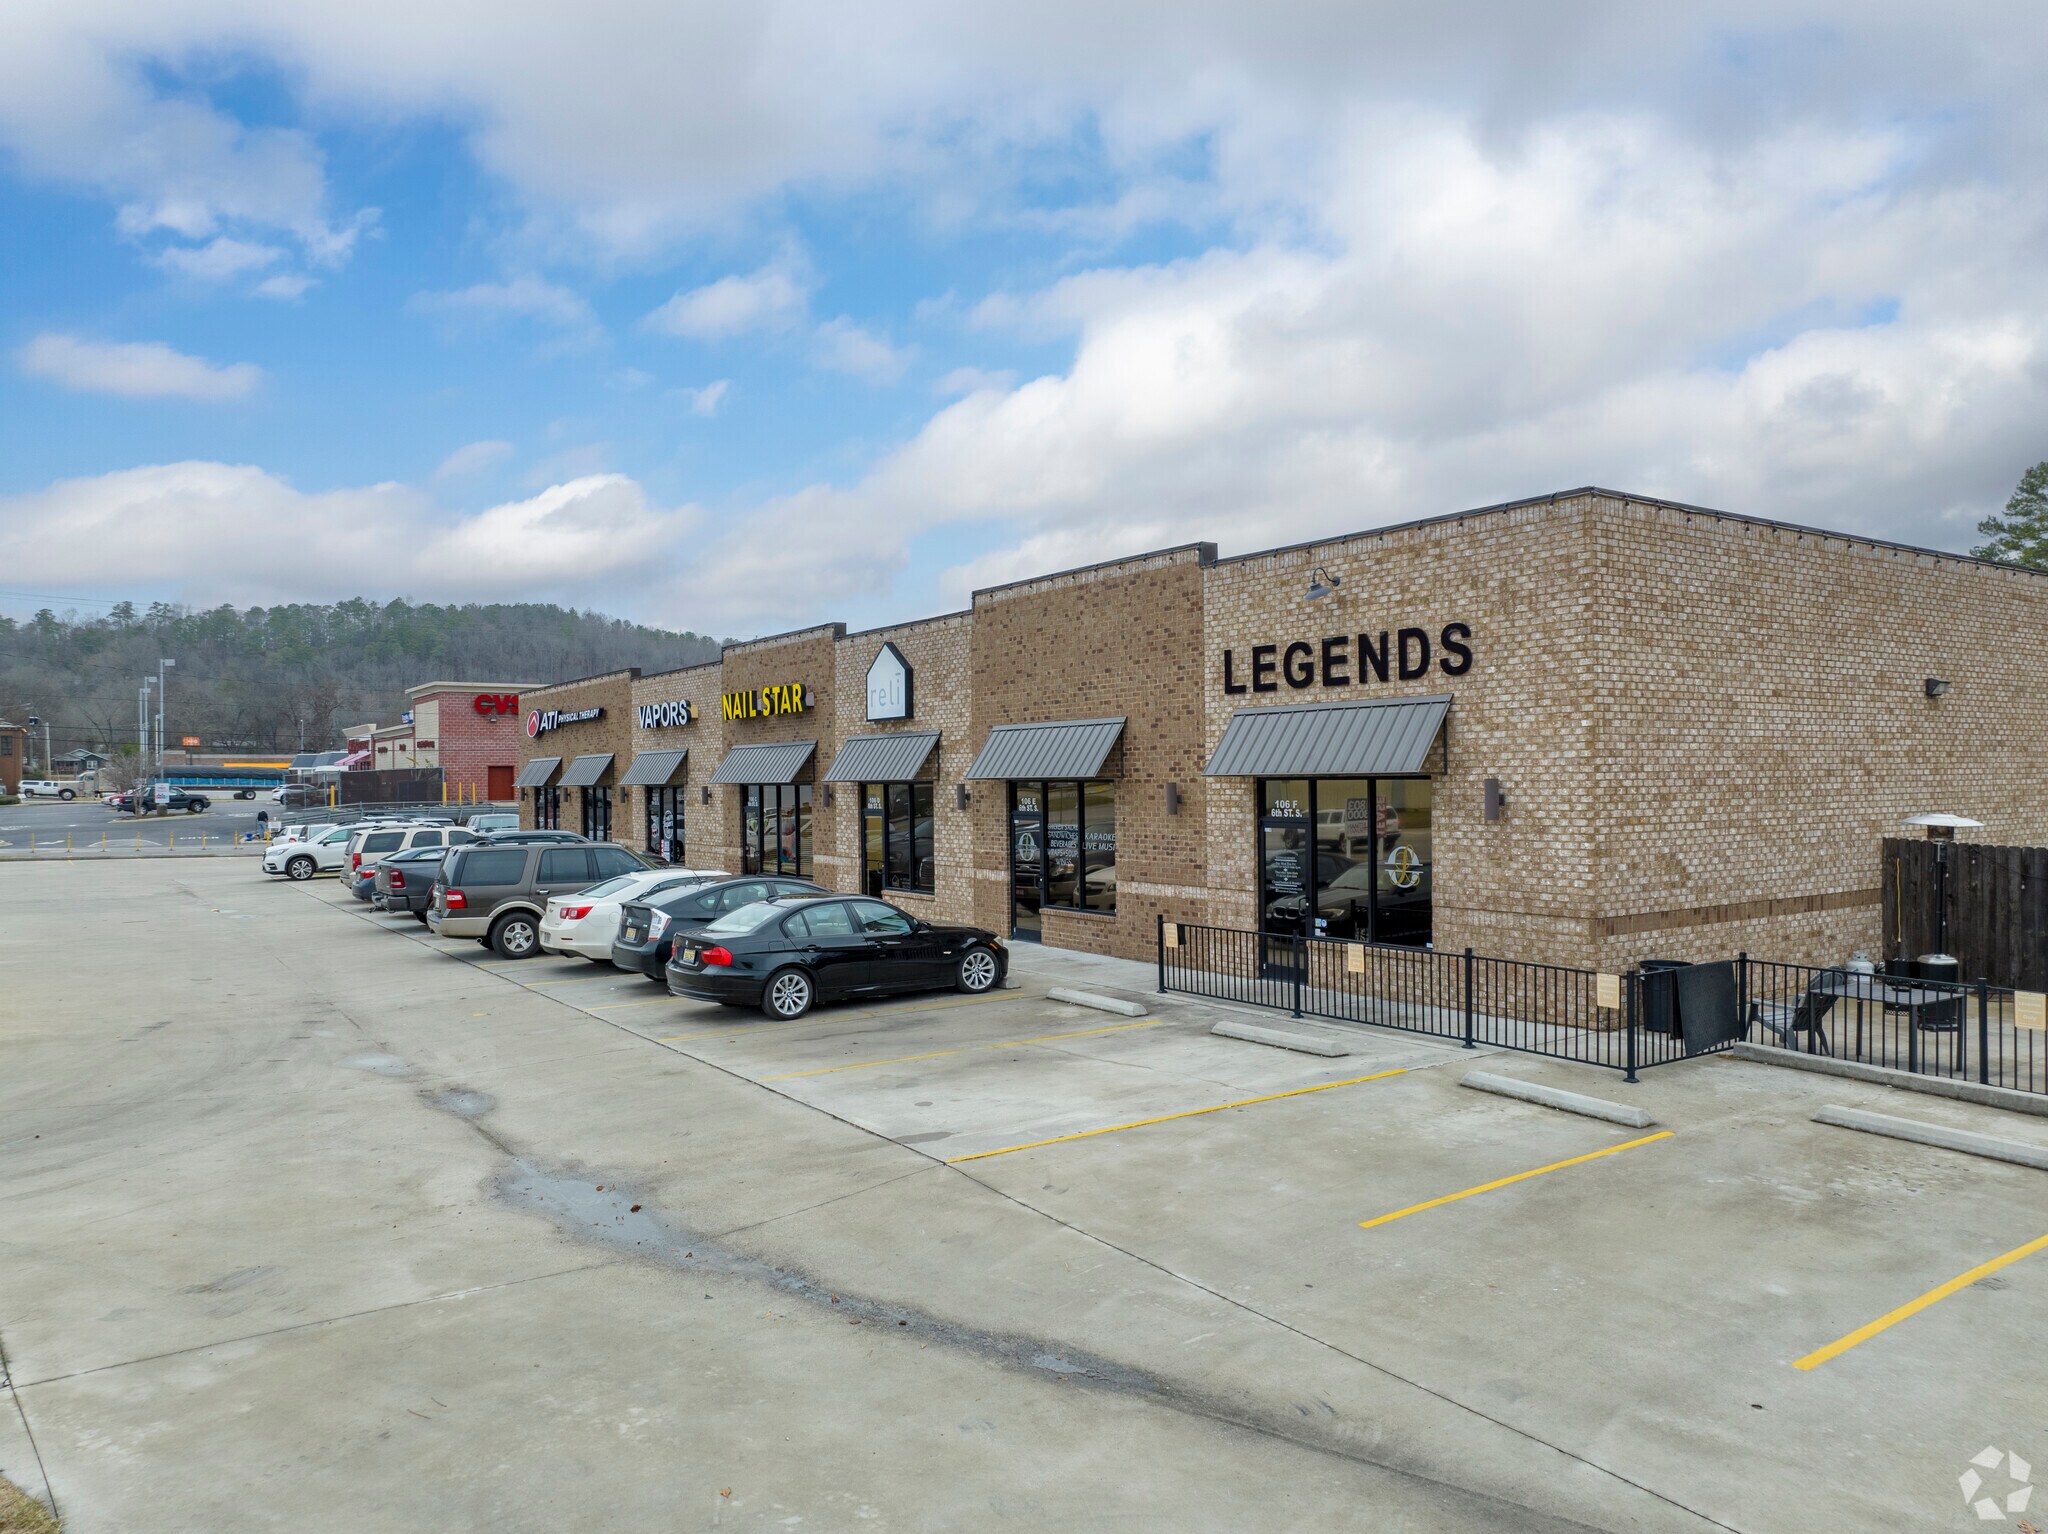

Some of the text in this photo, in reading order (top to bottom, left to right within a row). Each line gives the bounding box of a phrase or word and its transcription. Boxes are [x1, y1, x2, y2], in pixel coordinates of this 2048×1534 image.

[1224, 622, 1473, 694] LEGENDS
[722, 683, 803, 721] NAIL STAR
[638, 699, 687, 729] VAPORS
[540, 708, 599, 731] ATI PHYSICAL THERAPY
[1274, 800, 1298, 808] 106 F
[1271, 808, 1302, 818] 6th ST. S.
[1048, 831, 1078, 840] SANDWICHES
[1084, 832, 1116, 842] KARAOKE
[1050, 840, 1076, 848] BEVERAGES
[1082, 842, 1116, 852] LIVE MUSI
